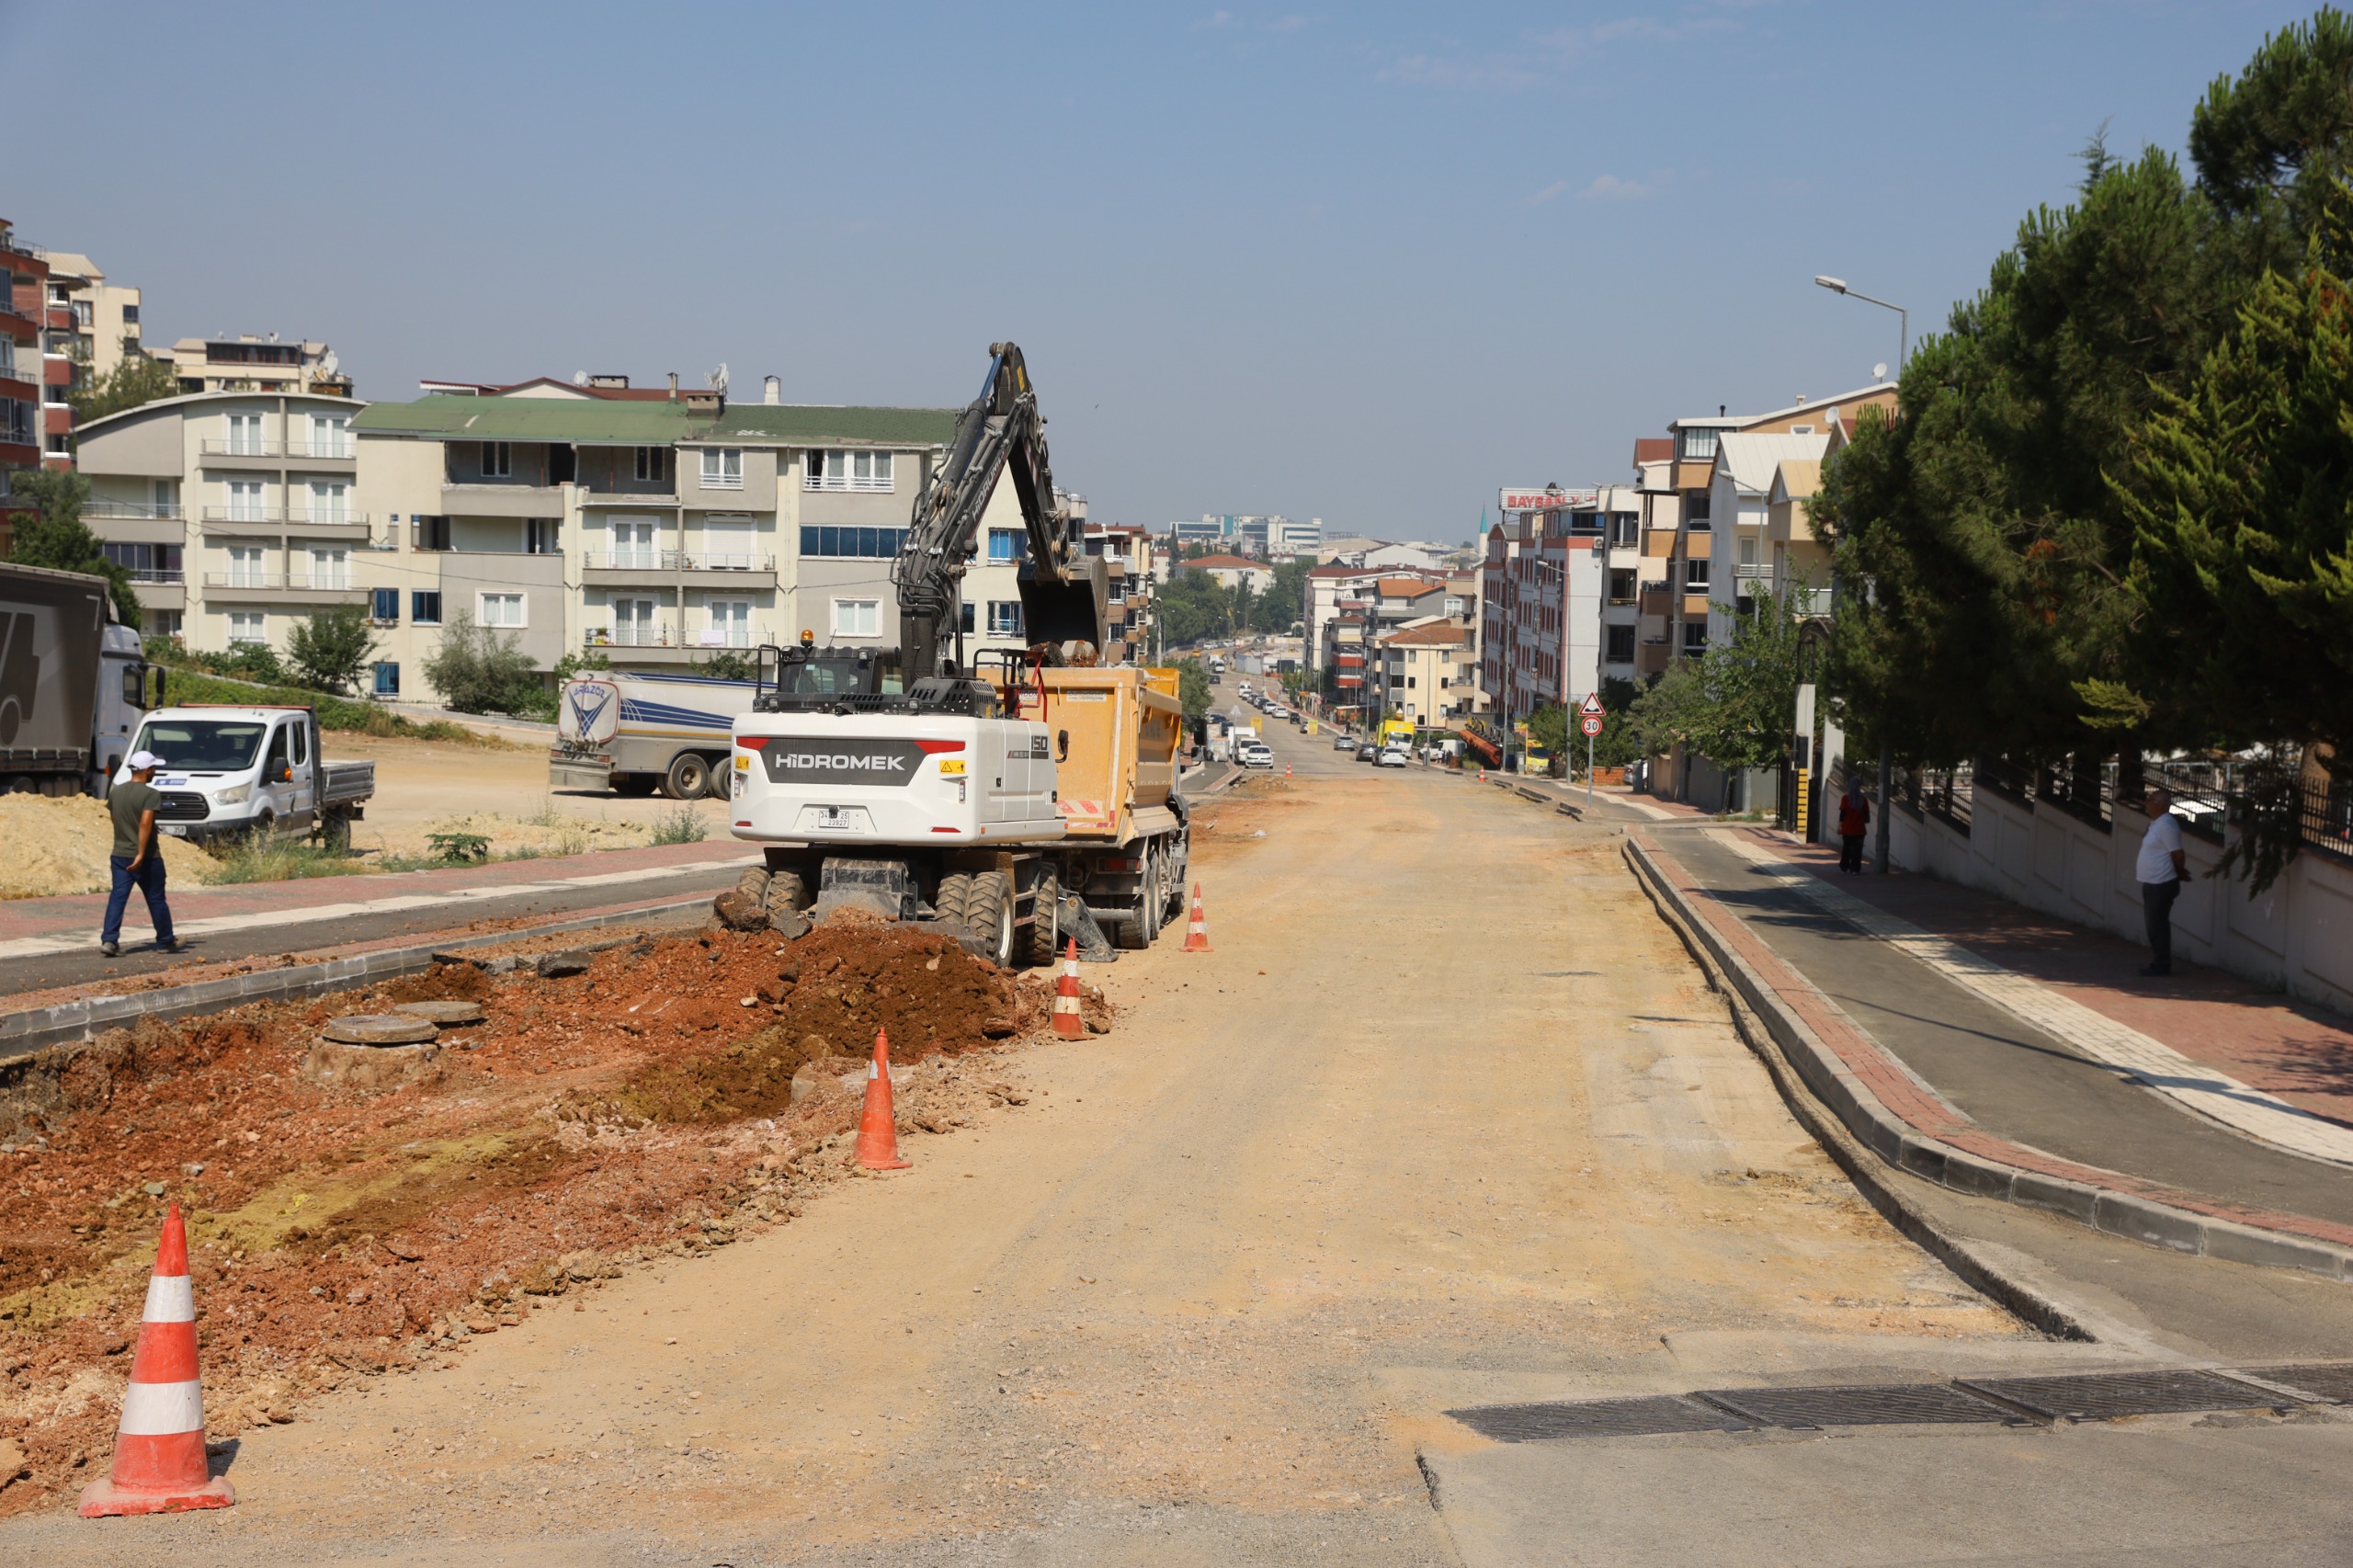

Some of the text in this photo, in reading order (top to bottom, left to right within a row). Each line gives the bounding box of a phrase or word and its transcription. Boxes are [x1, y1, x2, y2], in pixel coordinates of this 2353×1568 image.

[1507, 494, 1565, 508] BAYSAN
[1586, 721, 1598, 731] 30
[1031, 734, 1048, 751] 150
